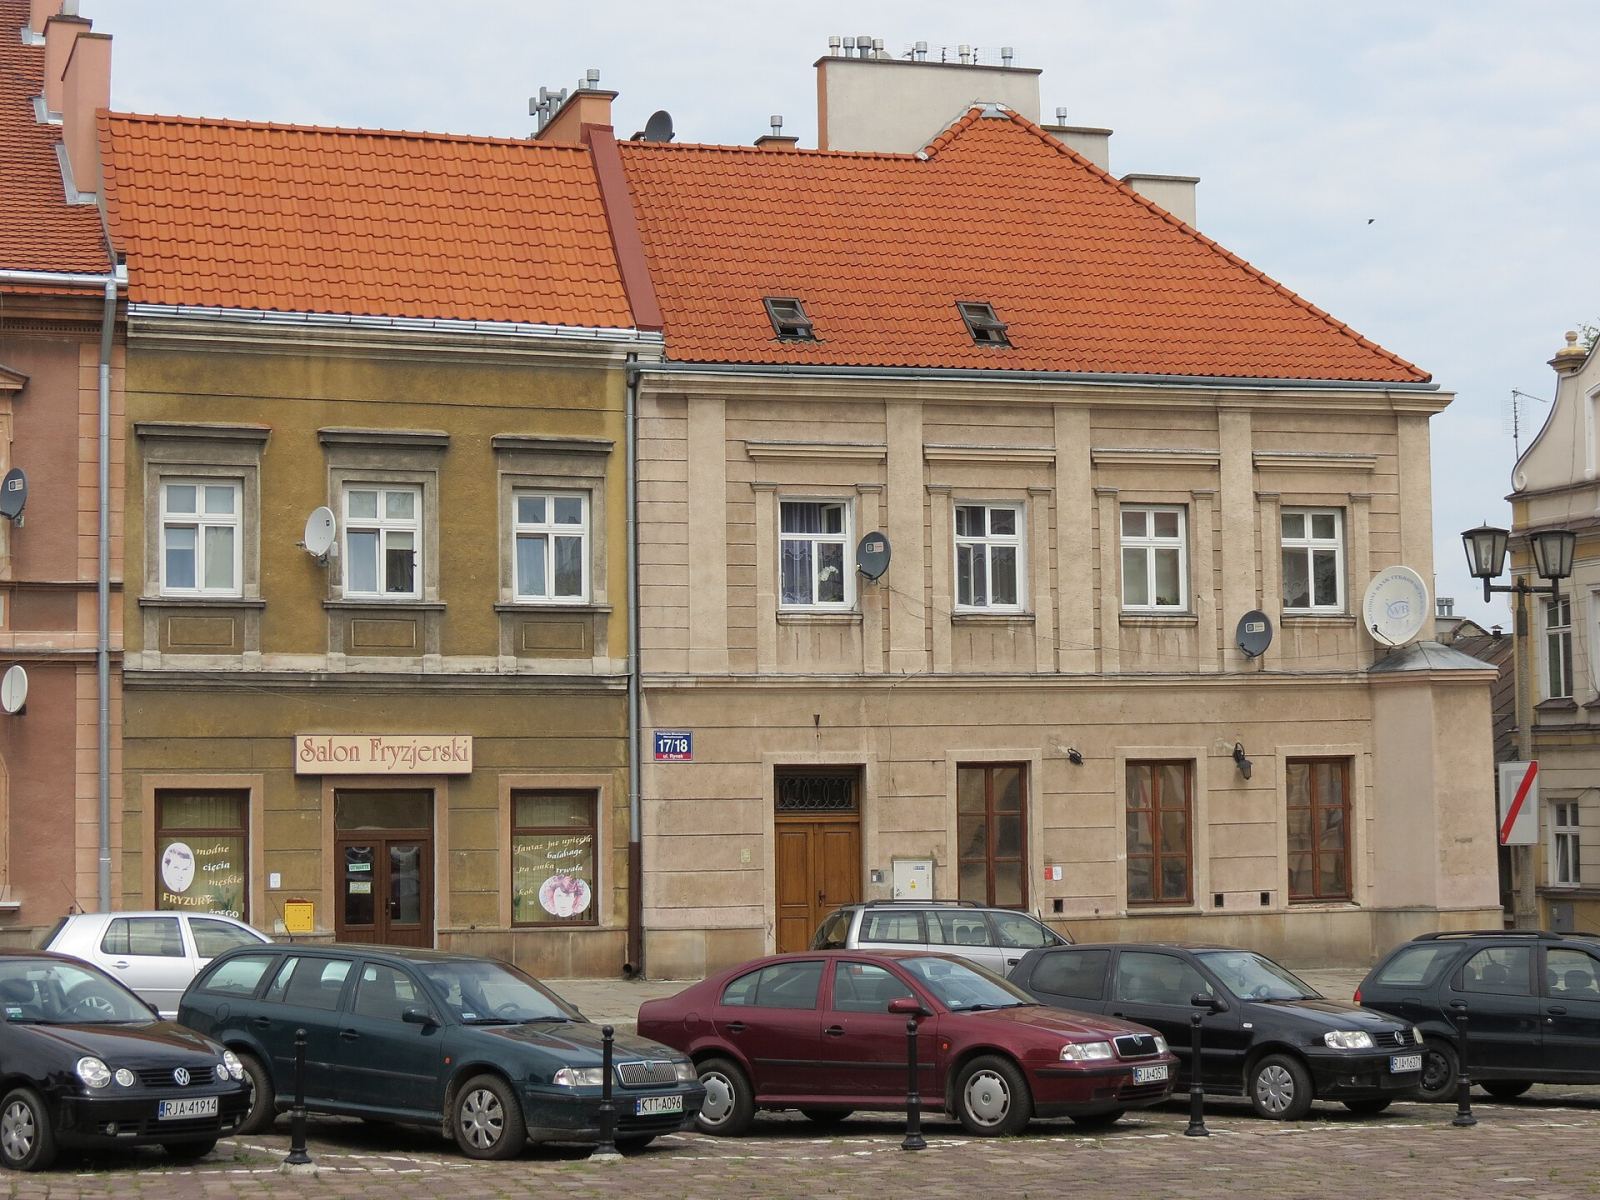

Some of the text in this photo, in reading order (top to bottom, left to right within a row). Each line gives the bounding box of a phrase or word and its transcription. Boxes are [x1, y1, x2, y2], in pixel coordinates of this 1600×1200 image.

[658, 739, 688, 753] 17/18
[300, 737, 468, 770] Salon Fryzjerski
[196, 844, 229, 855] modne
[203, 861, 230, 872] cięcia
[209, 875, 241, 888] męskie
[165, 1099, 217, 1116] RJA 41914
[642, 1098, 659, 1111] KTT
